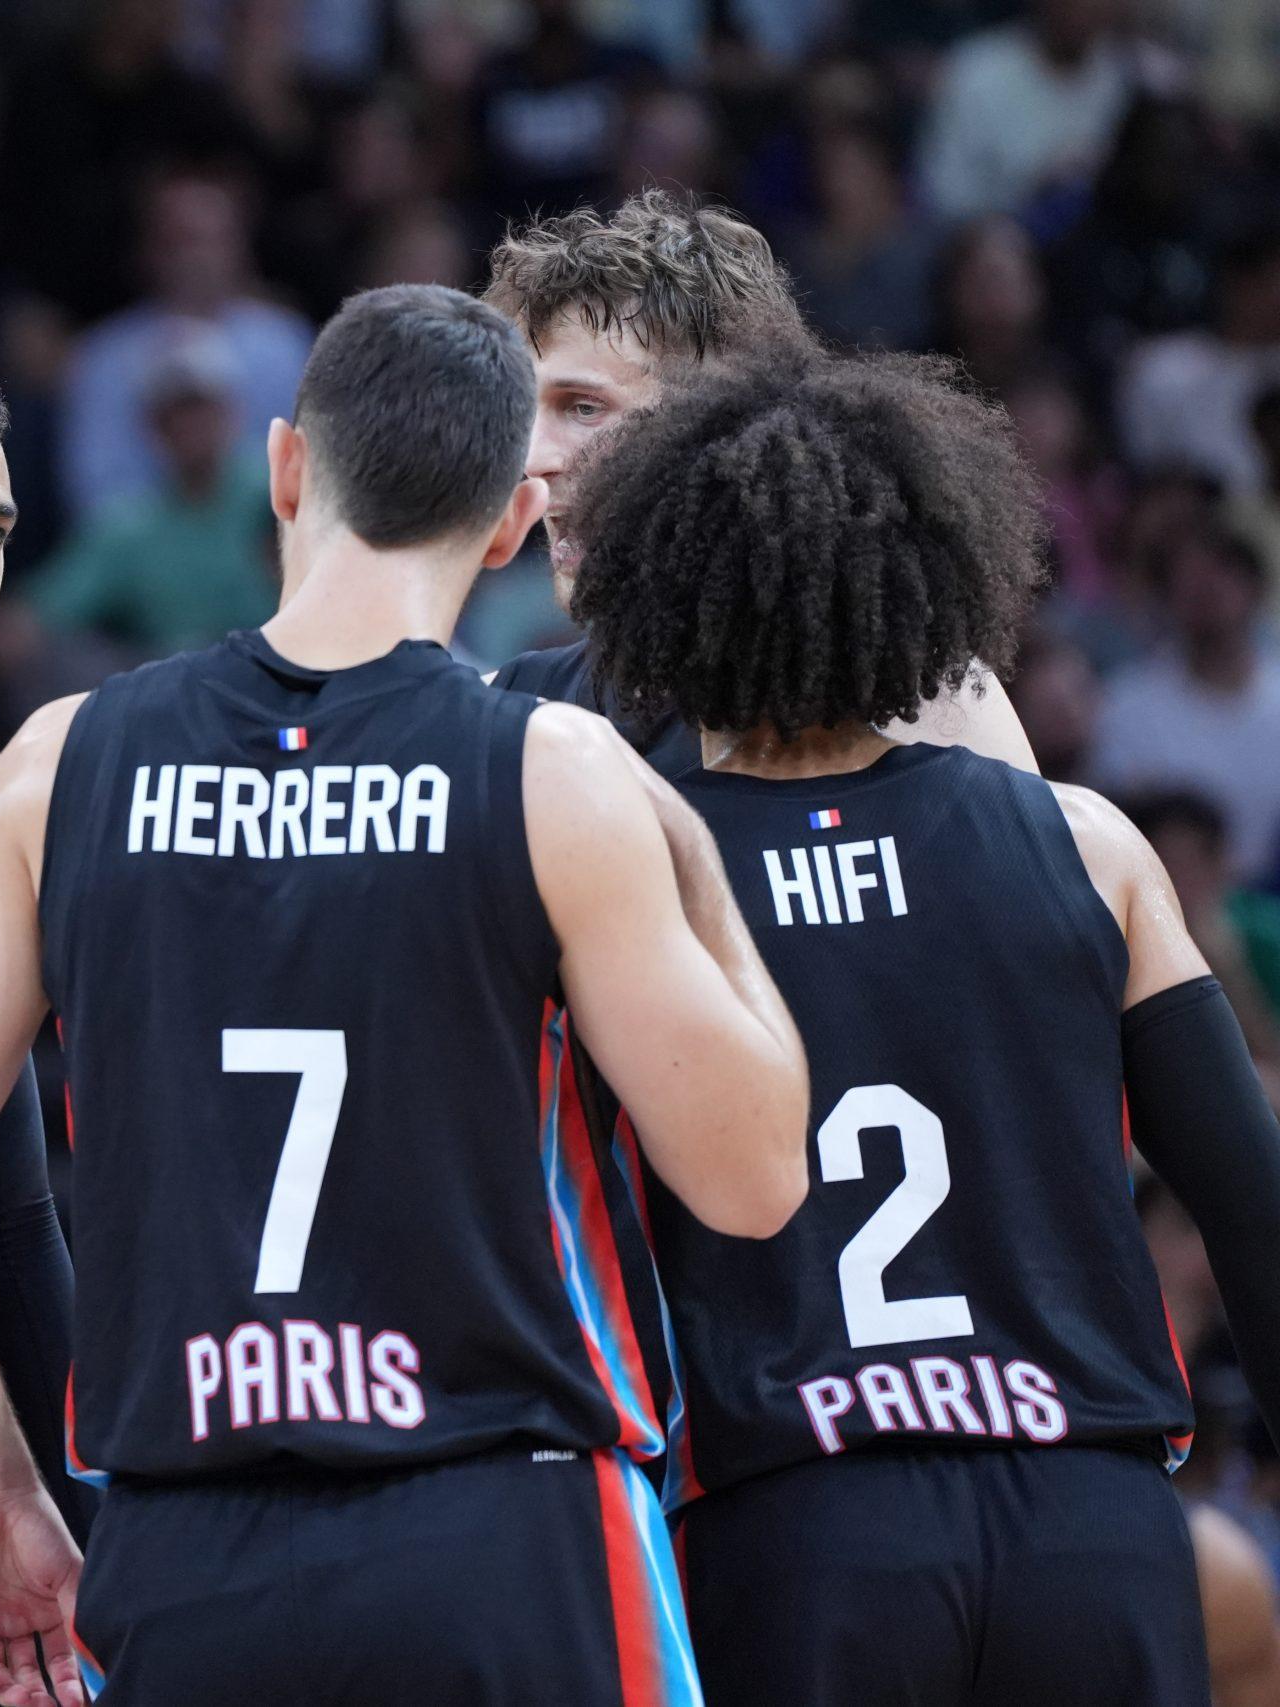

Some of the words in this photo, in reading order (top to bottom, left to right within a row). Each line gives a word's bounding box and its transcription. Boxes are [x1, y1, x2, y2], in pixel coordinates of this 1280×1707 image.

[127, 764, 450, 859] HERRERA
[762, 836, 908, 926] HIFI
[221, 1028, 348, 1294] 7
[817, 1083, 975, 1349] 2
[186, 1319, 426, 1443] PARIS
[797, 1355, 1068, 1456] PARIS
